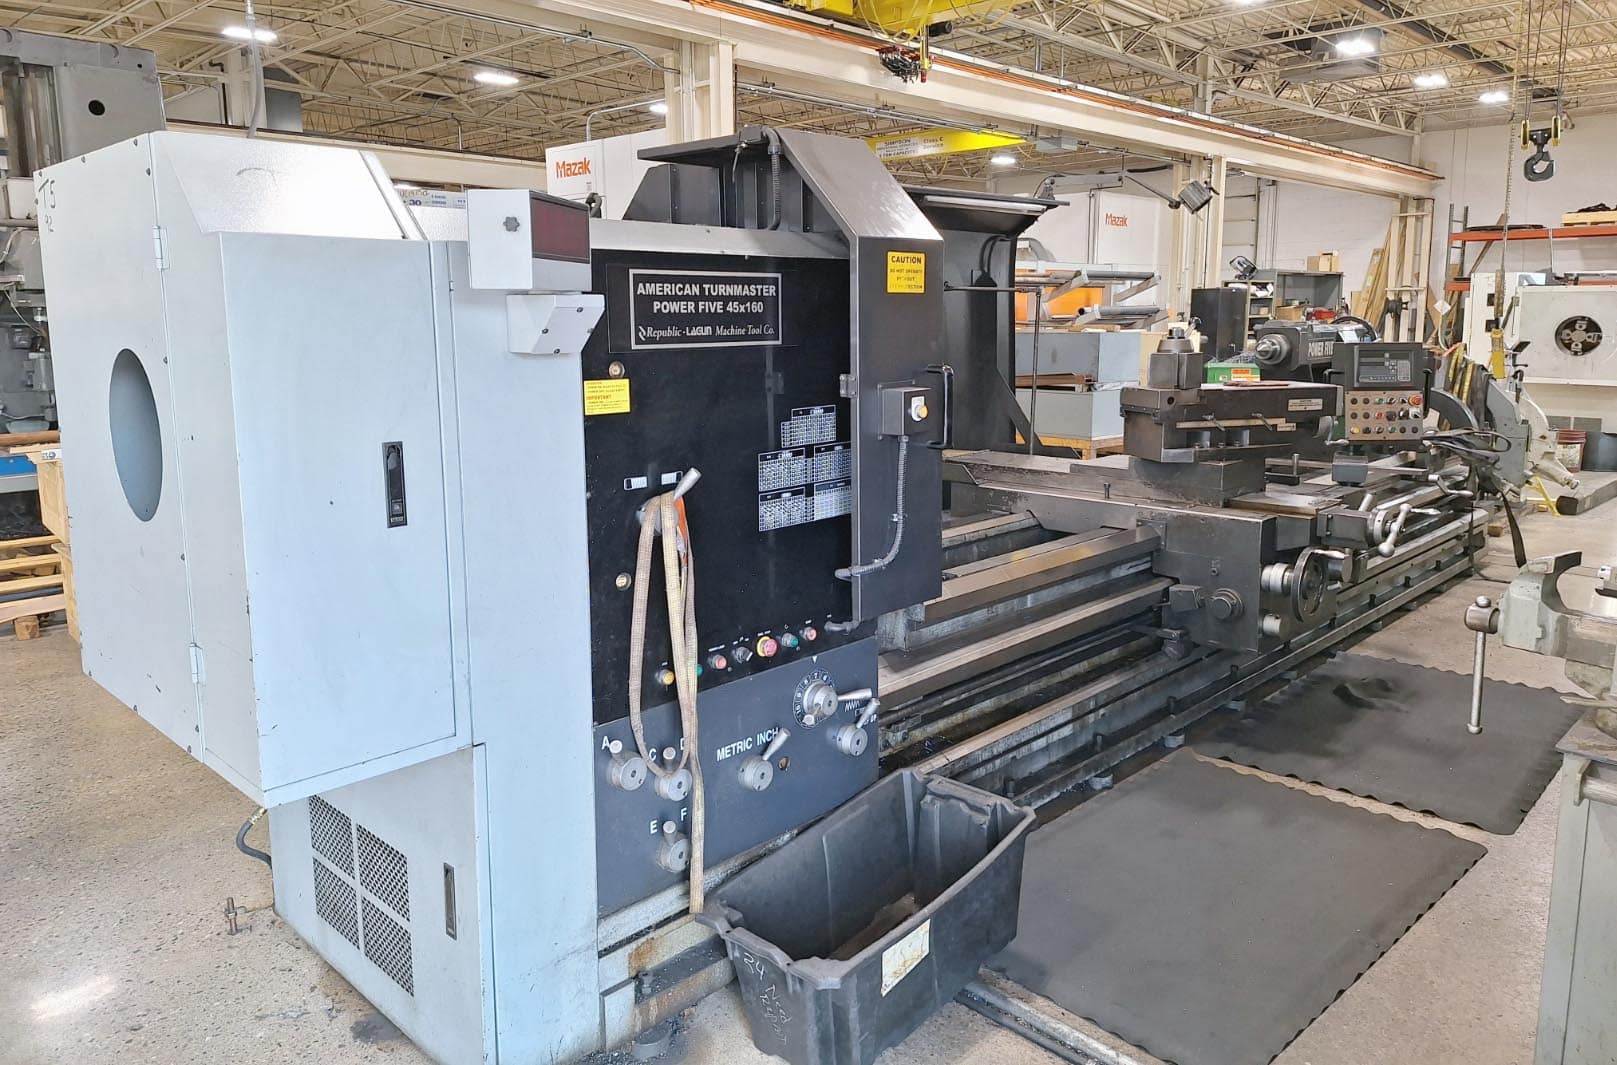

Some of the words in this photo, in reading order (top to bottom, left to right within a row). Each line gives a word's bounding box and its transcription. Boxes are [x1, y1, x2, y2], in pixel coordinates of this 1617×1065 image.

[556, 156, 591, 178] Mazak
[1105, 212, 1128, 227] Mazak
[891, 255, 922, 264] CAUTION
[636, 283, 700, 296] AMERICAN
[702, 284, 776, 296] TURNMASTER
[653, 301, 696, 314] POWER
[698, 301, 724, 313] FIVE
[726, 301, 764, 313] 45x160
[715, 324, 746, 337] Machine
[747, 324, 762, 336] Tool
[763, 323, 775, 335] Co.
[601, 736, 610, 750] A
[716, 738, 753, 761] METRIC
[756, 726, 779, 746] INCH
[648, 748, 657, 761] C
[681, 808, 687, 821] F
[650, 820, 658, 834] E
[743, 952, 765, 980] 24
